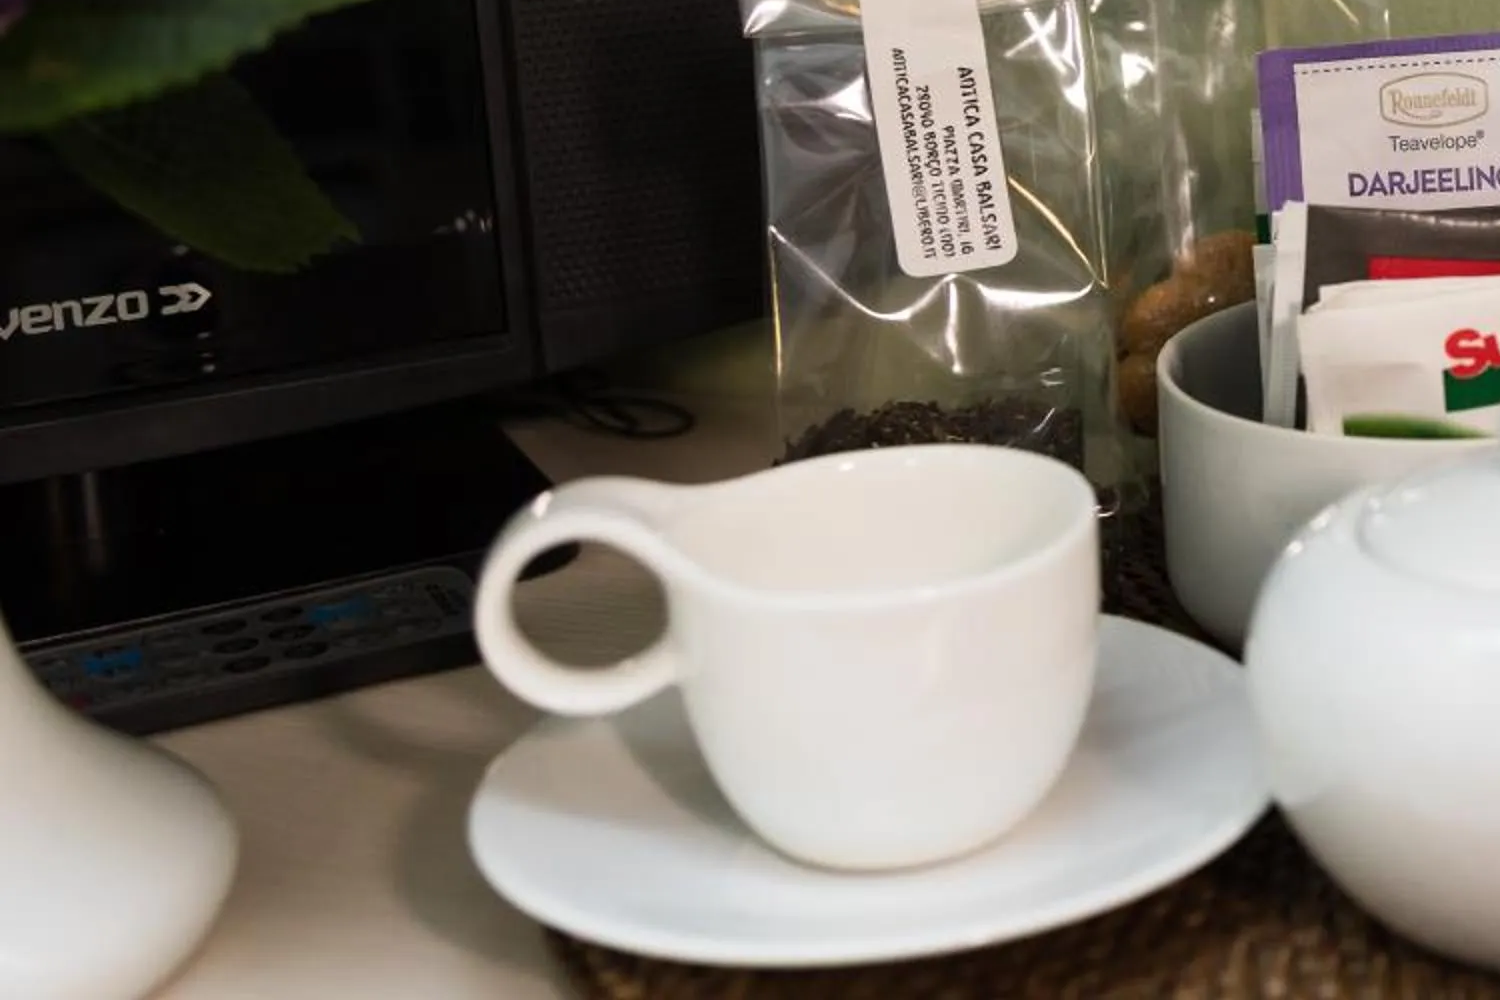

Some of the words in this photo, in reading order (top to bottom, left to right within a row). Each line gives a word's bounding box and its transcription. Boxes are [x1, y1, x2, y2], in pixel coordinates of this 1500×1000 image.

[957, 67, 980, 128] ANTICA
[1387, 85, 1478, 117] Ronnefeldt
[943, 125, 961, 175] PIAZZA
[968, 131, 989, 177] CASA
[975, 181, 1002, 251] BALSARI
